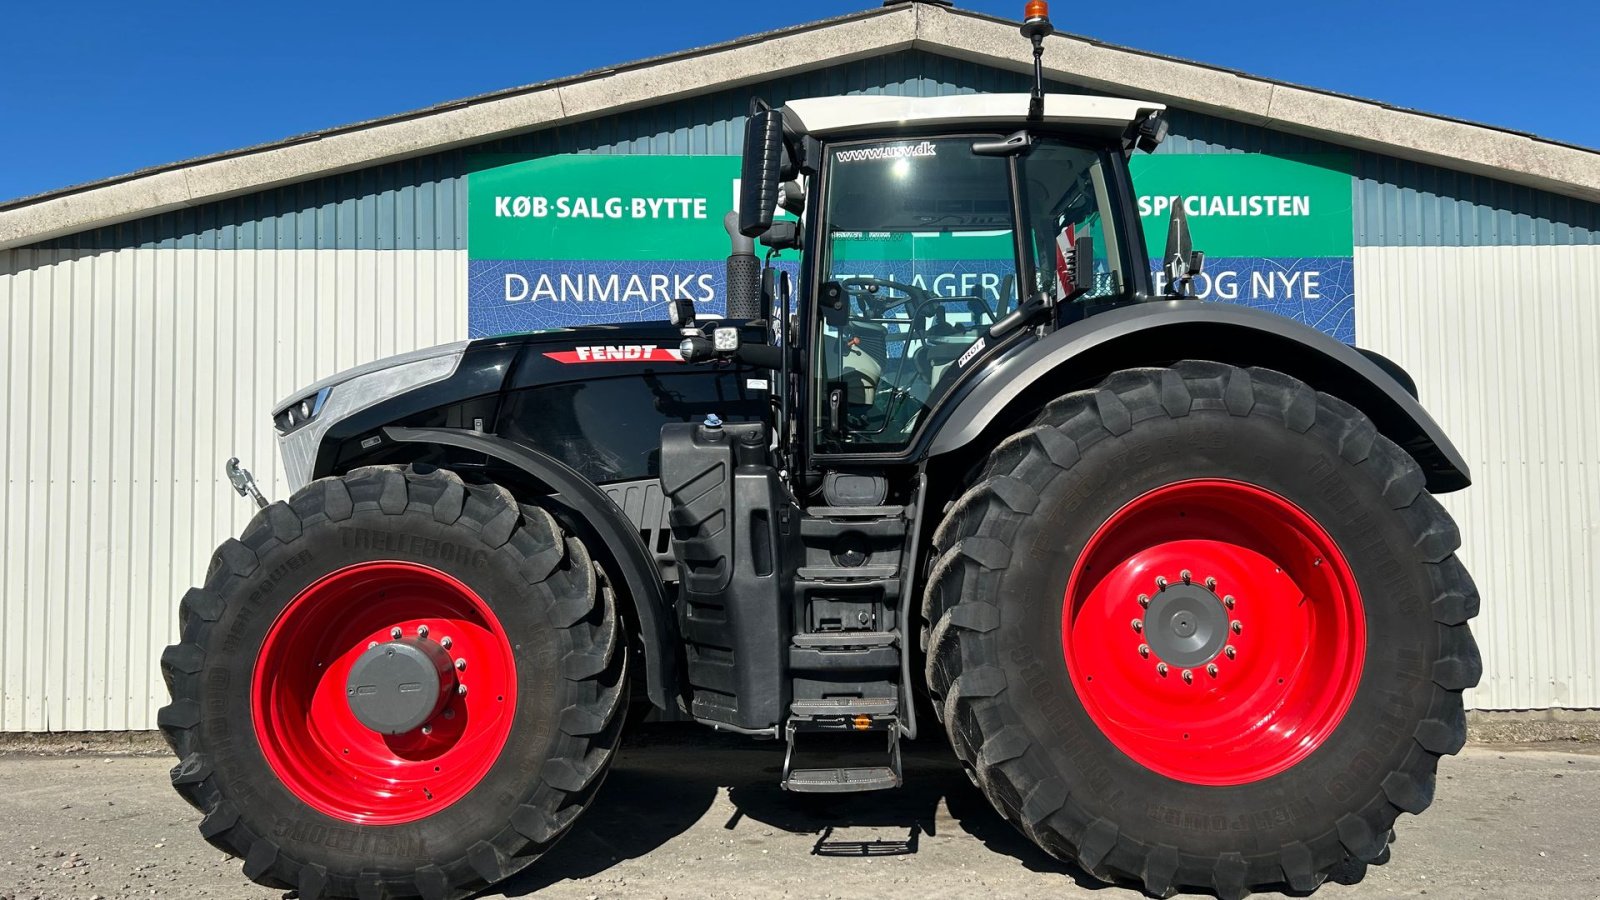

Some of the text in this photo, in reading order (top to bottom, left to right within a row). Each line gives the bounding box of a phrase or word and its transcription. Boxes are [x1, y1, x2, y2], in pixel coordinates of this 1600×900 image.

[836, 141, 936, 162] www.usv.dk
[505, 273, 715, 302] DANMARKS
[1252, 271, 1320, 299] NYE
[575, 344, 658, 361] FENDT
[338, 526, 489, 571] TRELLEBORG
